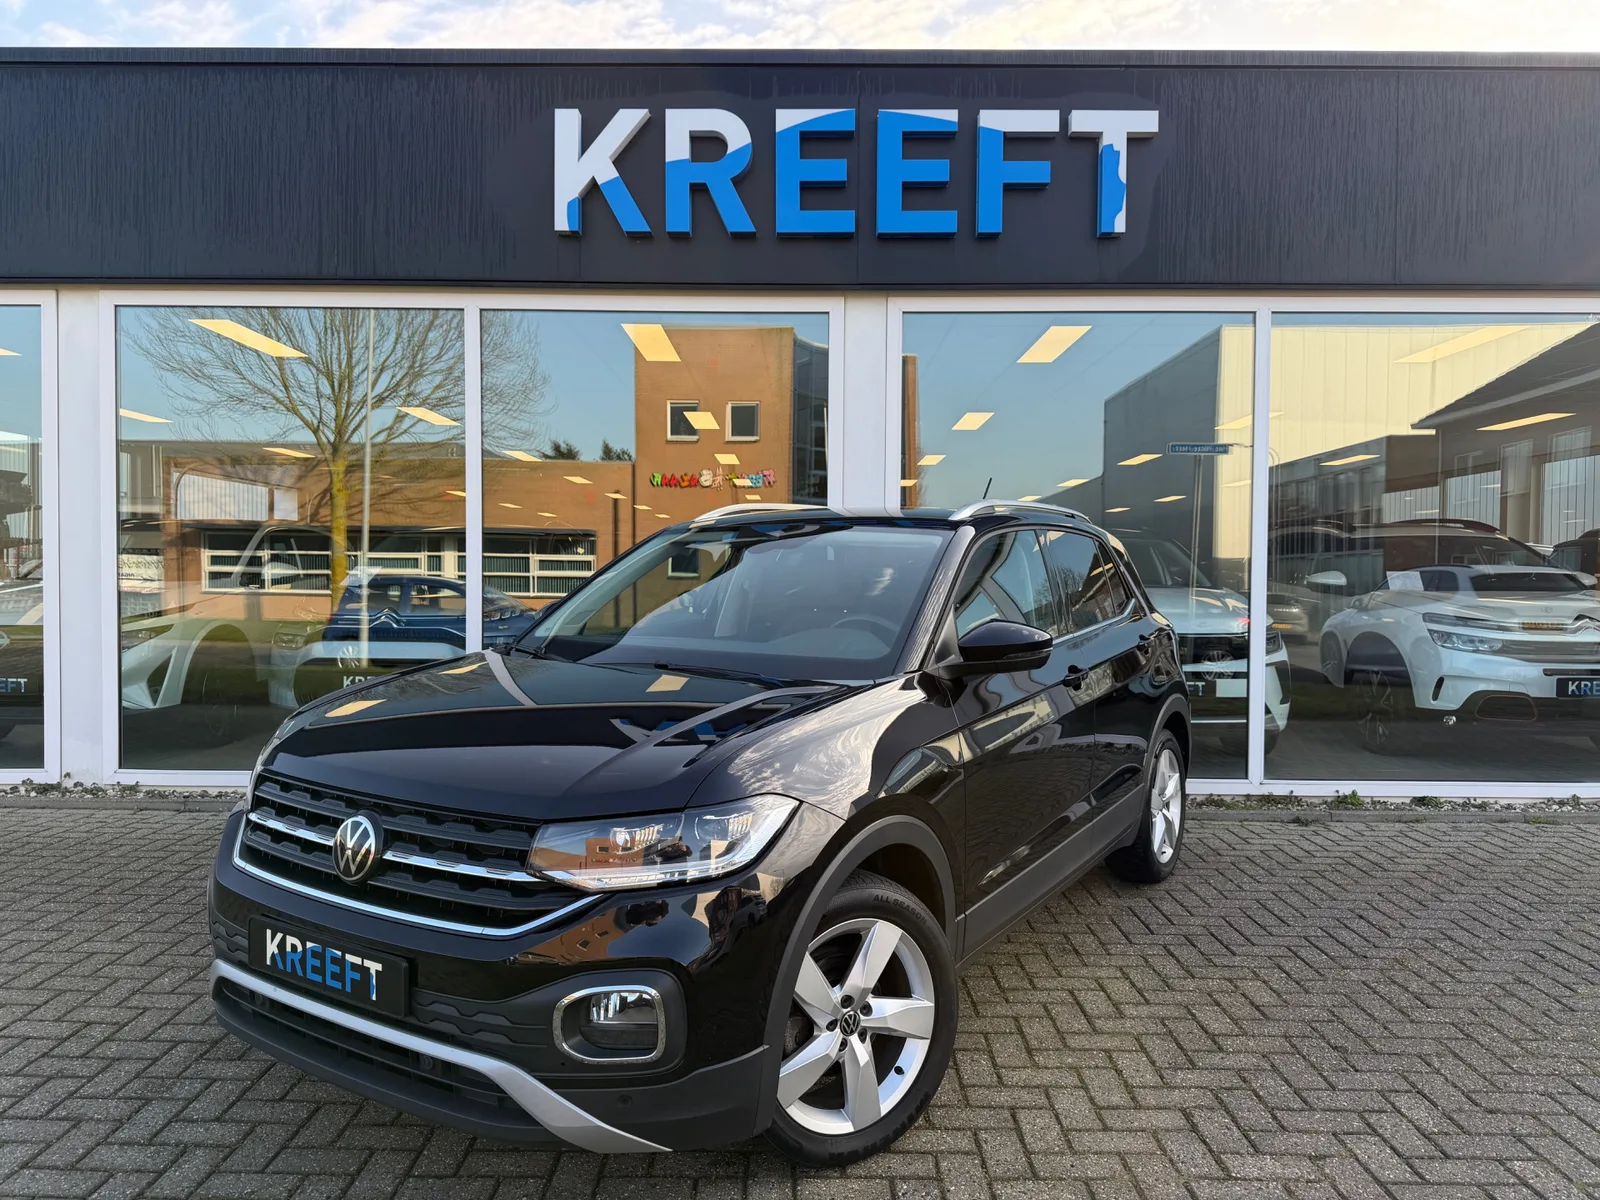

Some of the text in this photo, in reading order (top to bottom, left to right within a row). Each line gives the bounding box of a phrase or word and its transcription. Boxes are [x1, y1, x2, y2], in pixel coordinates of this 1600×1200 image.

[554, 108, 1159, 236] KREEFT
[873, 894, 928, 925] ALL SEASON
[266, 928, 382, 1001] KREEFT
